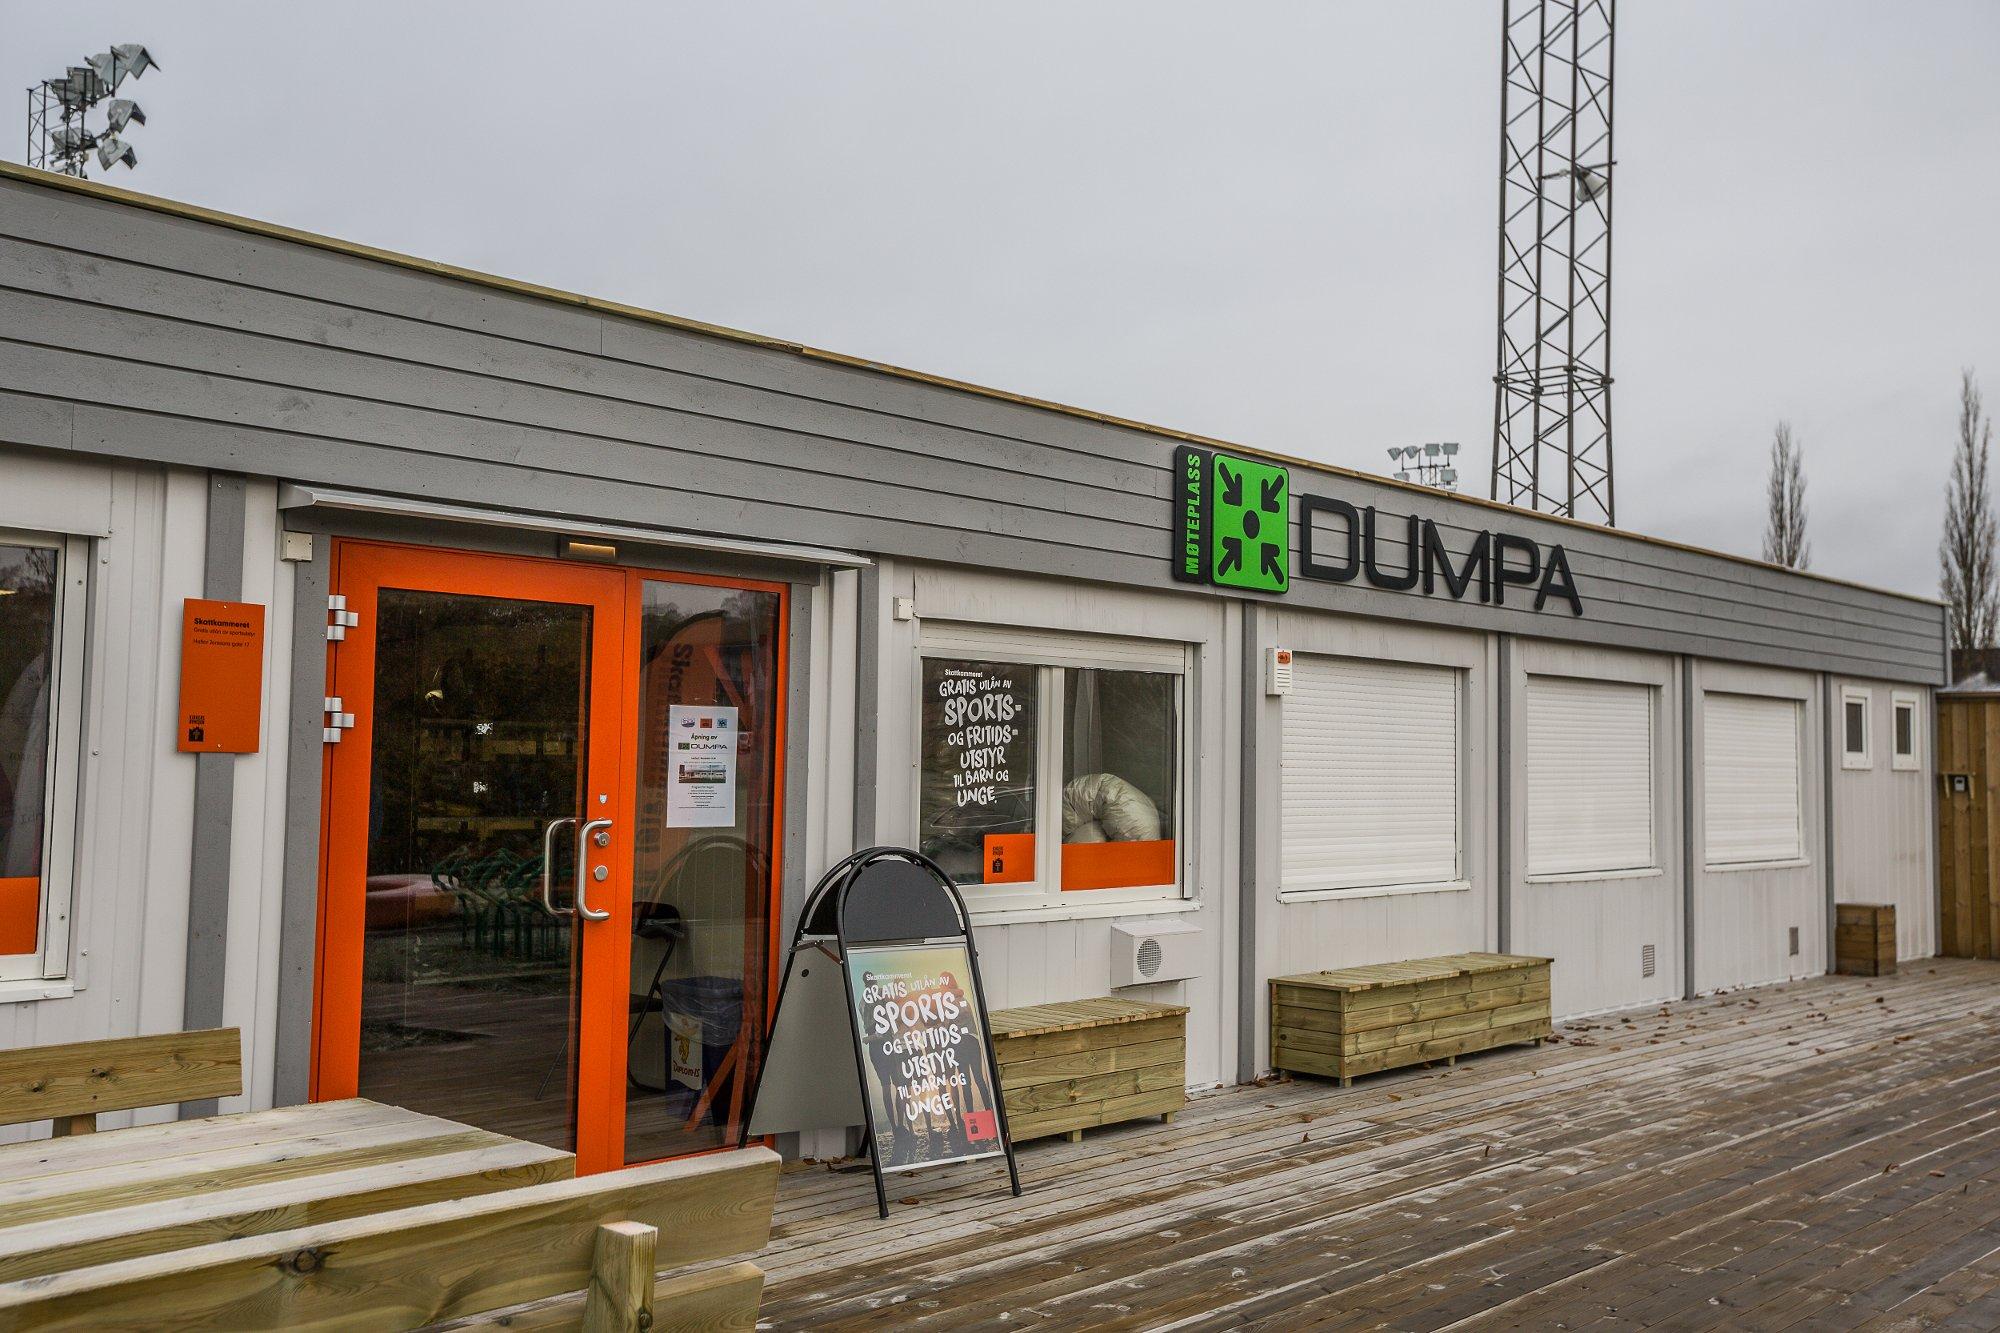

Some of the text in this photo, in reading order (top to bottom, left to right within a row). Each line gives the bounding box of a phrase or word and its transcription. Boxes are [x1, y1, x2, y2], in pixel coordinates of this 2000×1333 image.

[1186, 454, 1200, 575] MØTEPLASS
[1302, 492, 1583, 616] DUMPA
[194, 617, 250, 629] Skattkammeret
[939, 676, 1012, 697] GRATIS UTLÅN AV
[944, 669, 983, 678] Skattkammeret
[944, 693, 1022, 728] SPORTS-
[691, 733, 709, 741] Åpning
[948, 724, 1019, 748] OG FRITIDS-
[960, 746, 1006, 770] UTSTYR
[953, 768, 1009, 788] TIL BARN OG
[958, 786, 997, 807] UNGE.
[862, 975, 950, 1004] GRATIS UTLÅN AV
[866, 972, 912, 981] Skattkammeret
[873, 991, 968, 1035] SPORTS-
[882, 1024, 969, 1056] OG FRITIDS-
[902, 1048, 959, 1079] UTSTYR
[897, 1072, 967, 1100] TIL BARN OG
[905, 1093, 957, 1121] UNGE.
